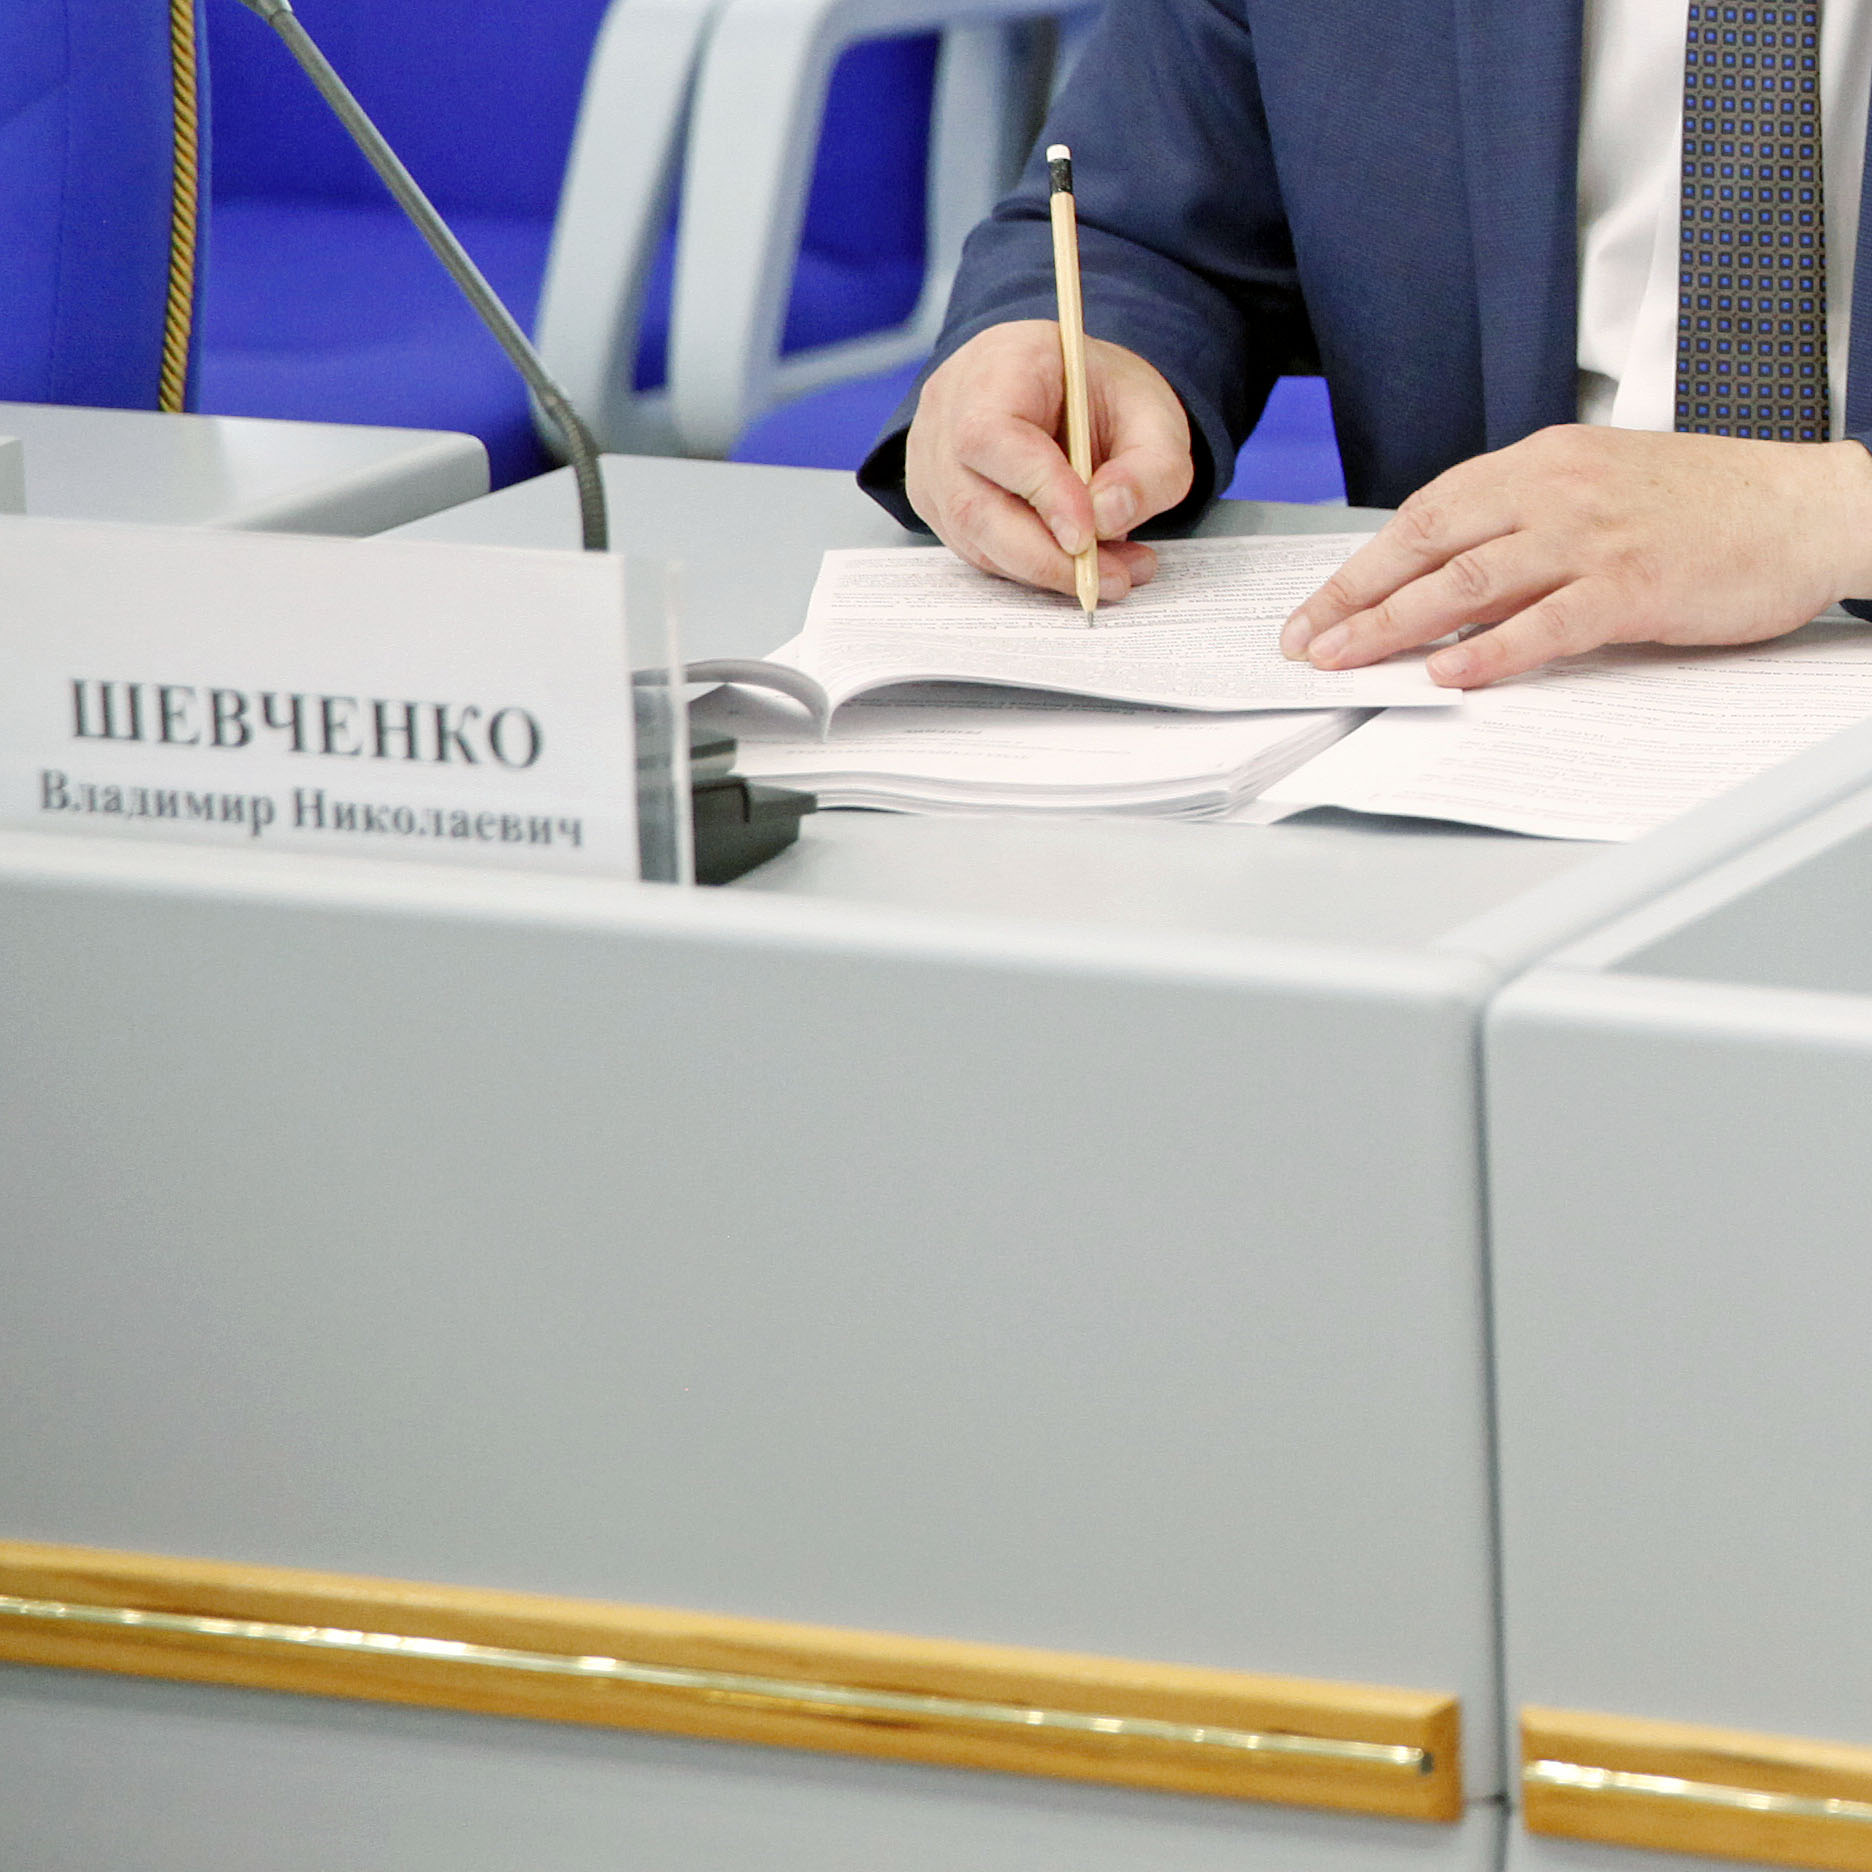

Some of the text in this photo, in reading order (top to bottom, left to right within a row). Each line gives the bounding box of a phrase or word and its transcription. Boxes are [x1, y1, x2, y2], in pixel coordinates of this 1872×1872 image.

[71, 678, 545, 769] ШЕВЧЕНКО
[38, 769, 585, 848] Владимир Николаевич
